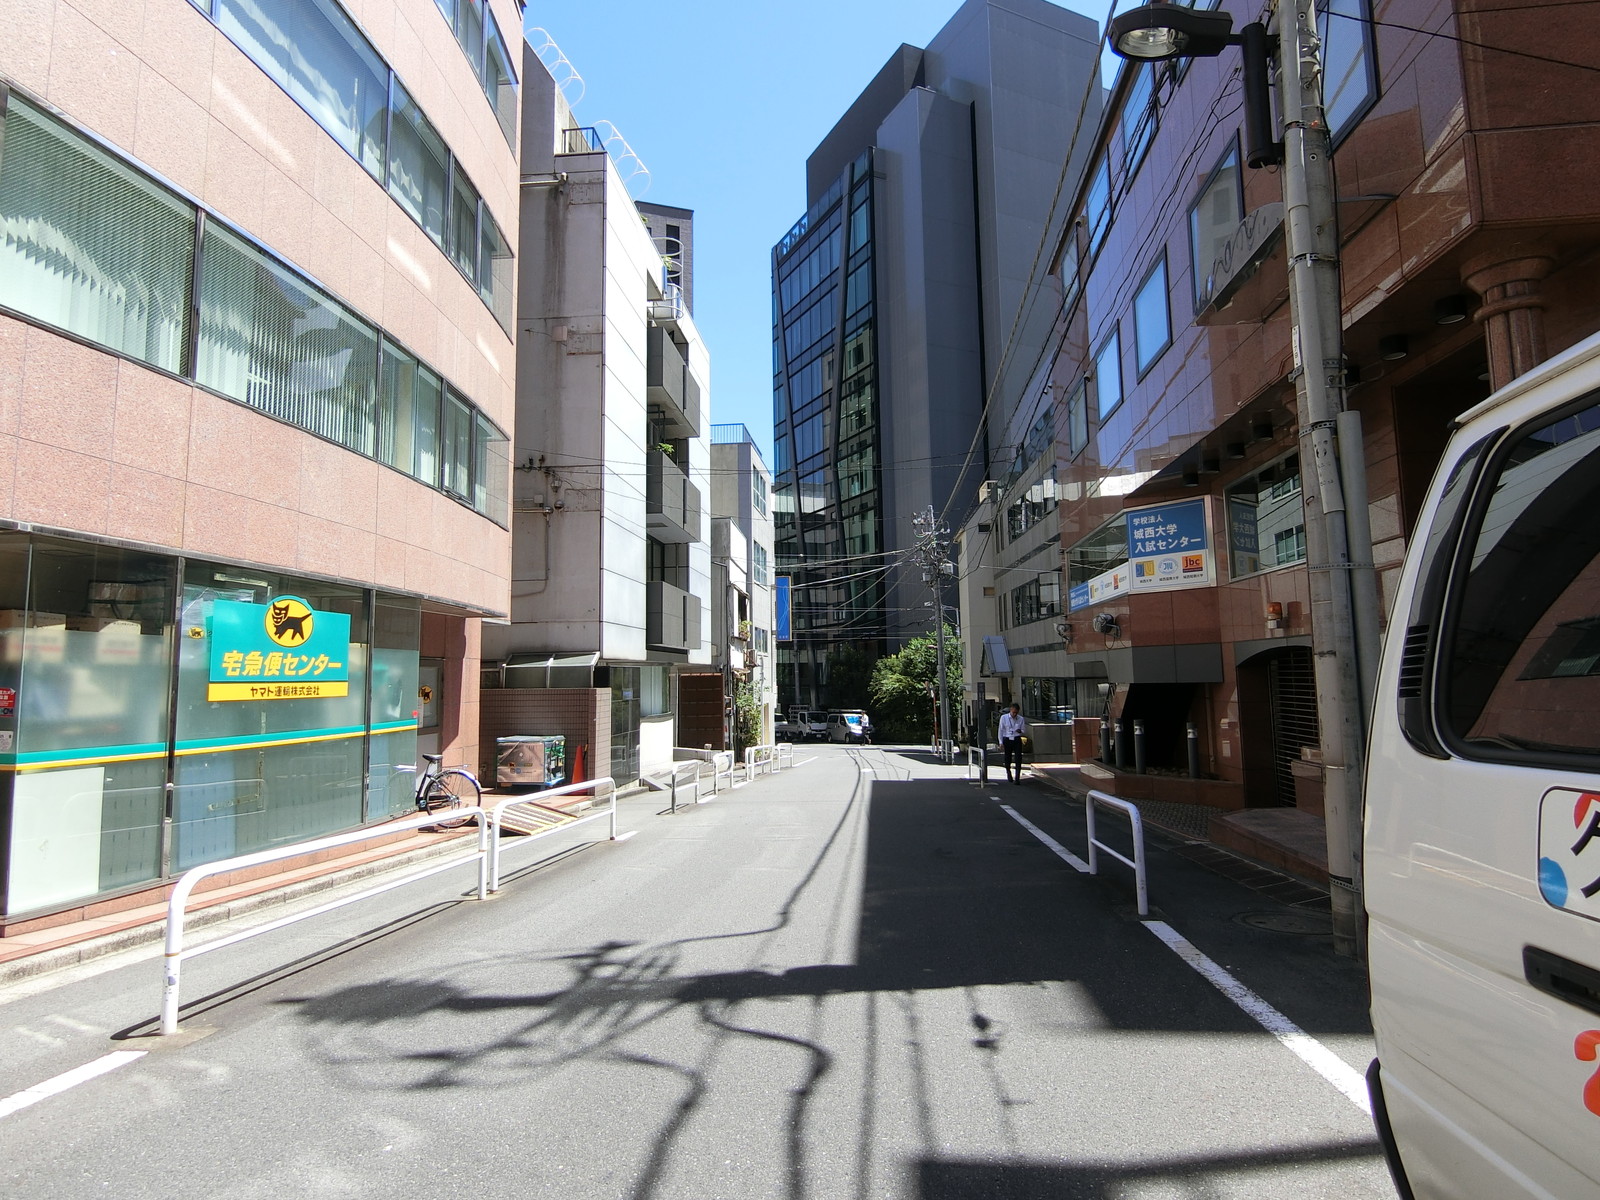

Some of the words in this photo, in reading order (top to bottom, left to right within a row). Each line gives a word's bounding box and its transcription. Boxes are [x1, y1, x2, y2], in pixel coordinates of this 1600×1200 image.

[1133, 514, 1163, 526] 学校法人
[1134, 523, 1177, 540] 城西大学
[1135, 536, 1201, 553] 入試センター
[1184, 556, 1201, 568] jbc
[222, 650, 343, 677] 宅急便センター
[250, 685, 320, 698] ヤマト運輸株式会社
